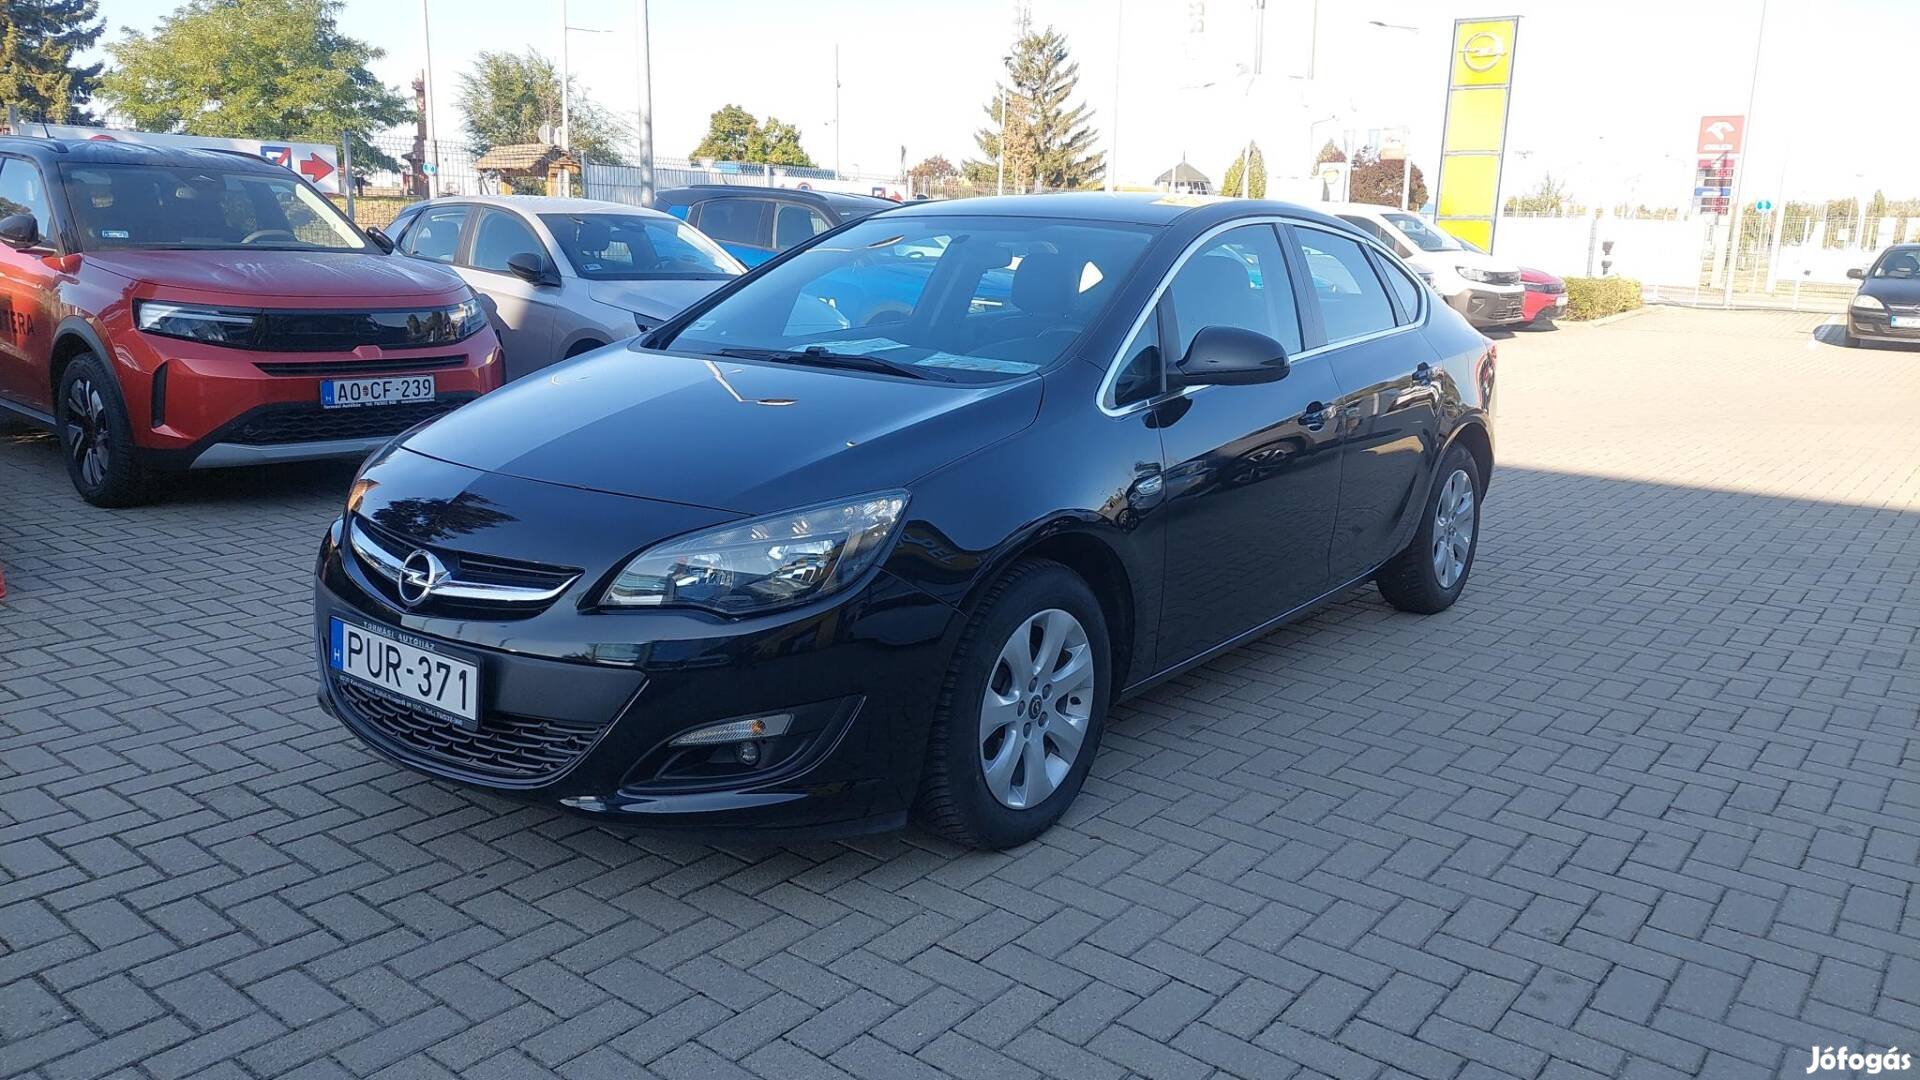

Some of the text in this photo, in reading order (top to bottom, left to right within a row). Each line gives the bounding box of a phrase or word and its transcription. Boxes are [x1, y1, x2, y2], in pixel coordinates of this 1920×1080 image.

[338, 382, 361, 402] AO
[370, 379, 431, 400] CF-239
[333, 648, 341, 662] H
[348, 631, 467, 711] PUR-371
